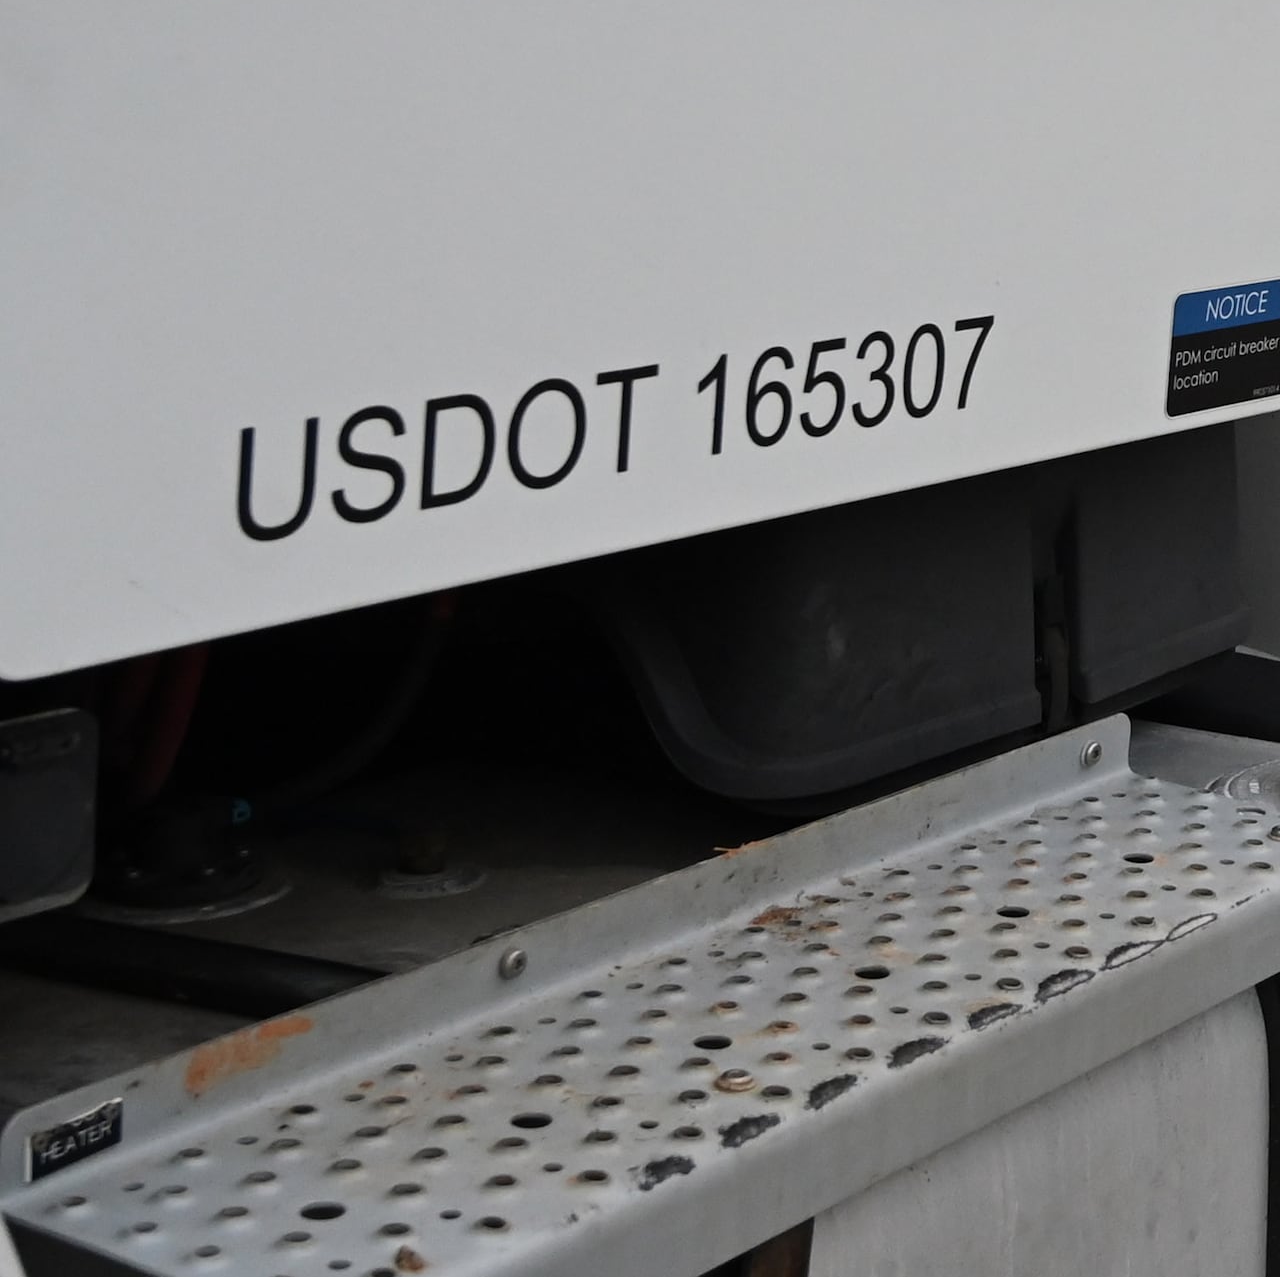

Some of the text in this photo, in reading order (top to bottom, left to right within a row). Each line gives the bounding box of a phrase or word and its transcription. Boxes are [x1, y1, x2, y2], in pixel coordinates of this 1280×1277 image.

[1206, 290, 1269, 322] NOTICE
[1175, 336, 1280, 368] PDM circuit breaker
[1173, 369, 1218, 390] location
[237, 314, 996, 542] USDOT 165307
